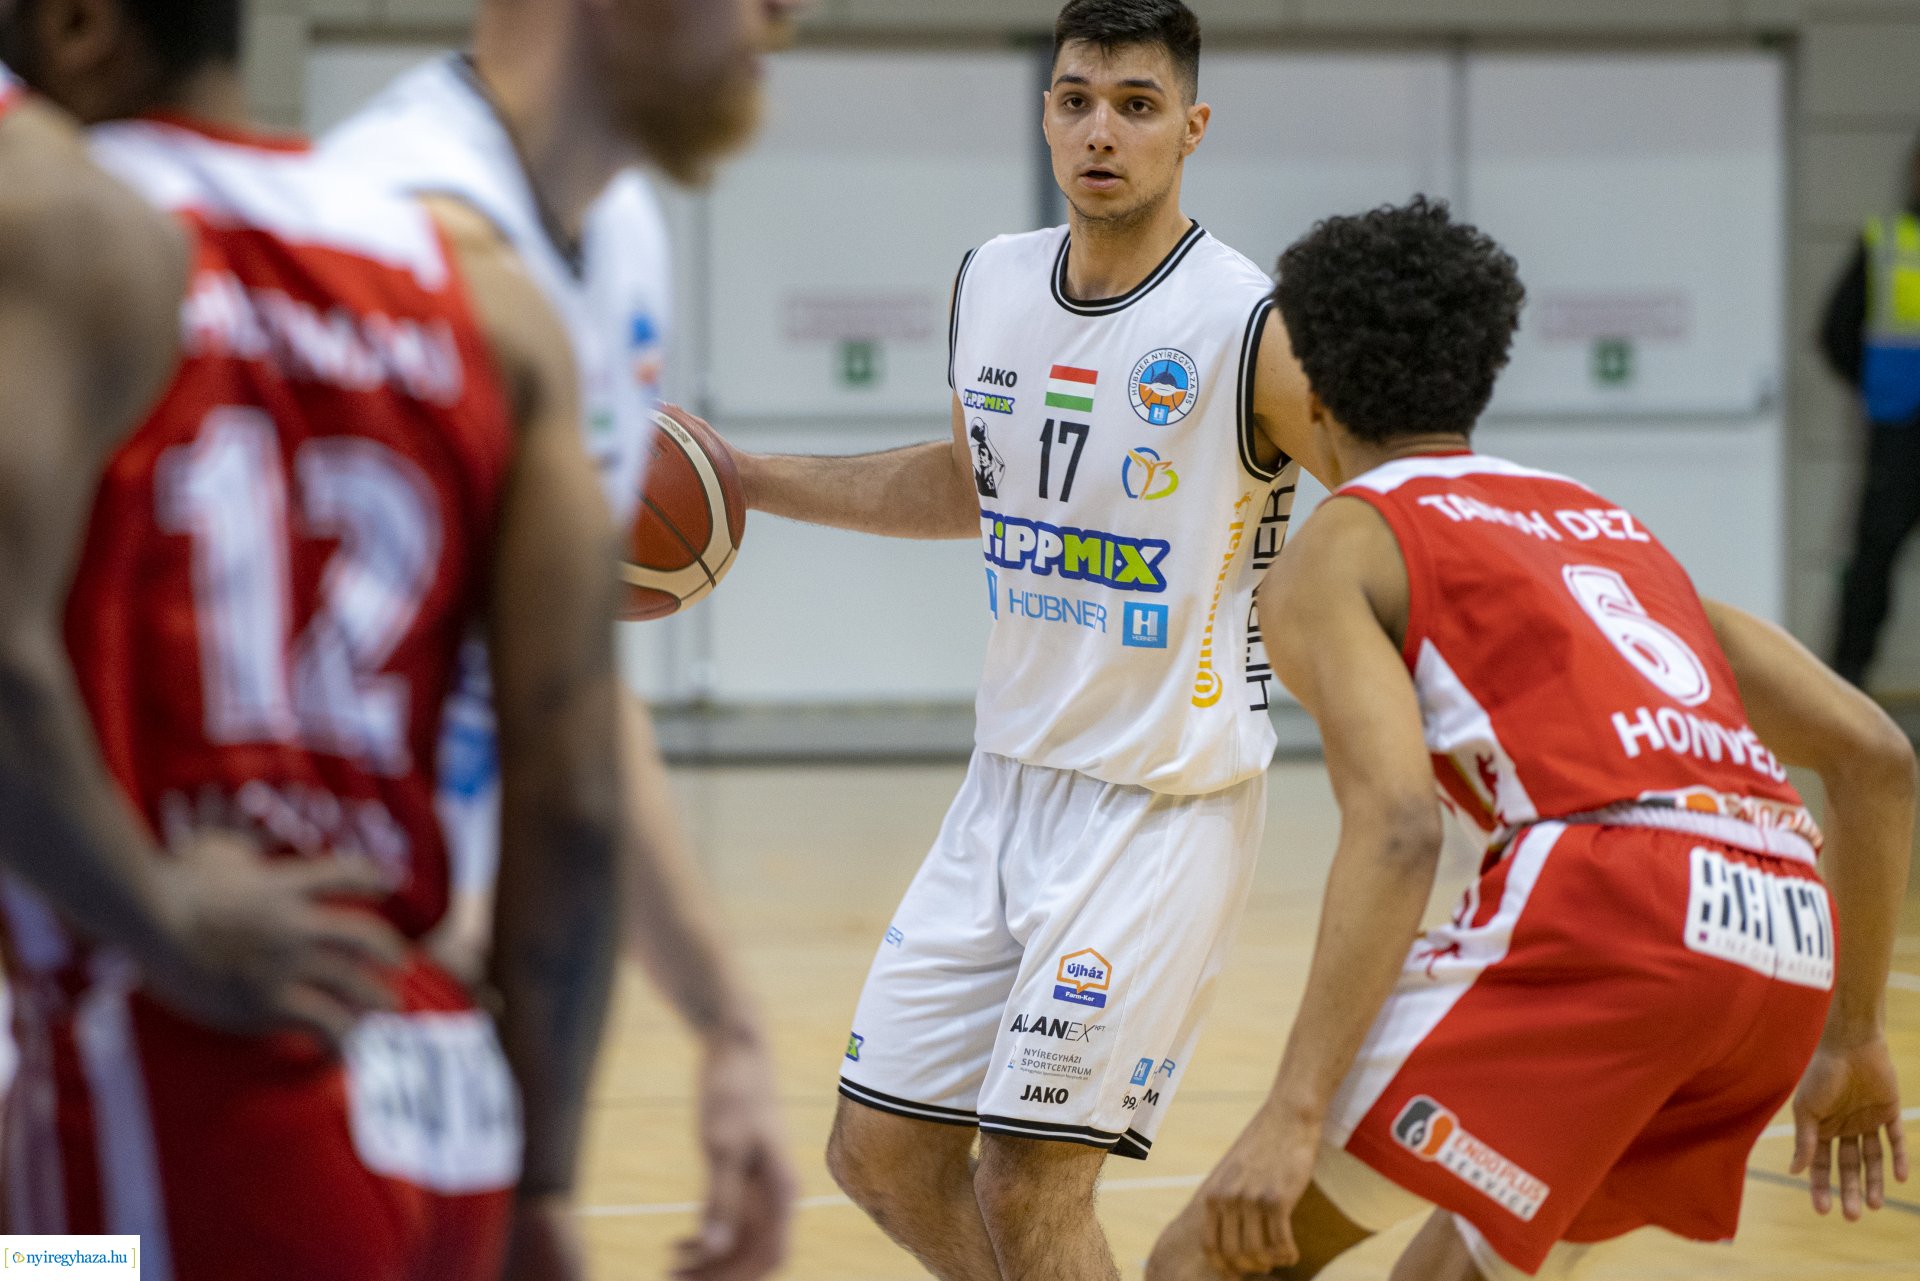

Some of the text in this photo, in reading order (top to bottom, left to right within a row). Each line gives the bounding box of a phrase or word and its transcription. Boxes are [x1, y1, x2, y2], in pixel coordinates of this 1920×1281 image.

[977, 365, 1018, 388] JAKO
[1038, 417, 1091, 503] 17
[1418, 494, 1650, 543] TAH DEZ
[154, 403, 445, 778] 12
[1245, 484, 1297, 711] HÜER
[1008, 587, 1108, 634] HÜBNER
[1132, 608, 1159, 635] H
[1561, 562, 1712, 707] 6
[1065, 991, 1095, 1002] Farm-Ker
[1010, 1013, 1095, 1043] ALANEX
[1021, 1058, 1092, 1076] SPORTCENTRUM
[1023, 1047, 1082, 1064] NYÍREGYHÁZI
[1020, 1084, 1069, 1105] JAKO
